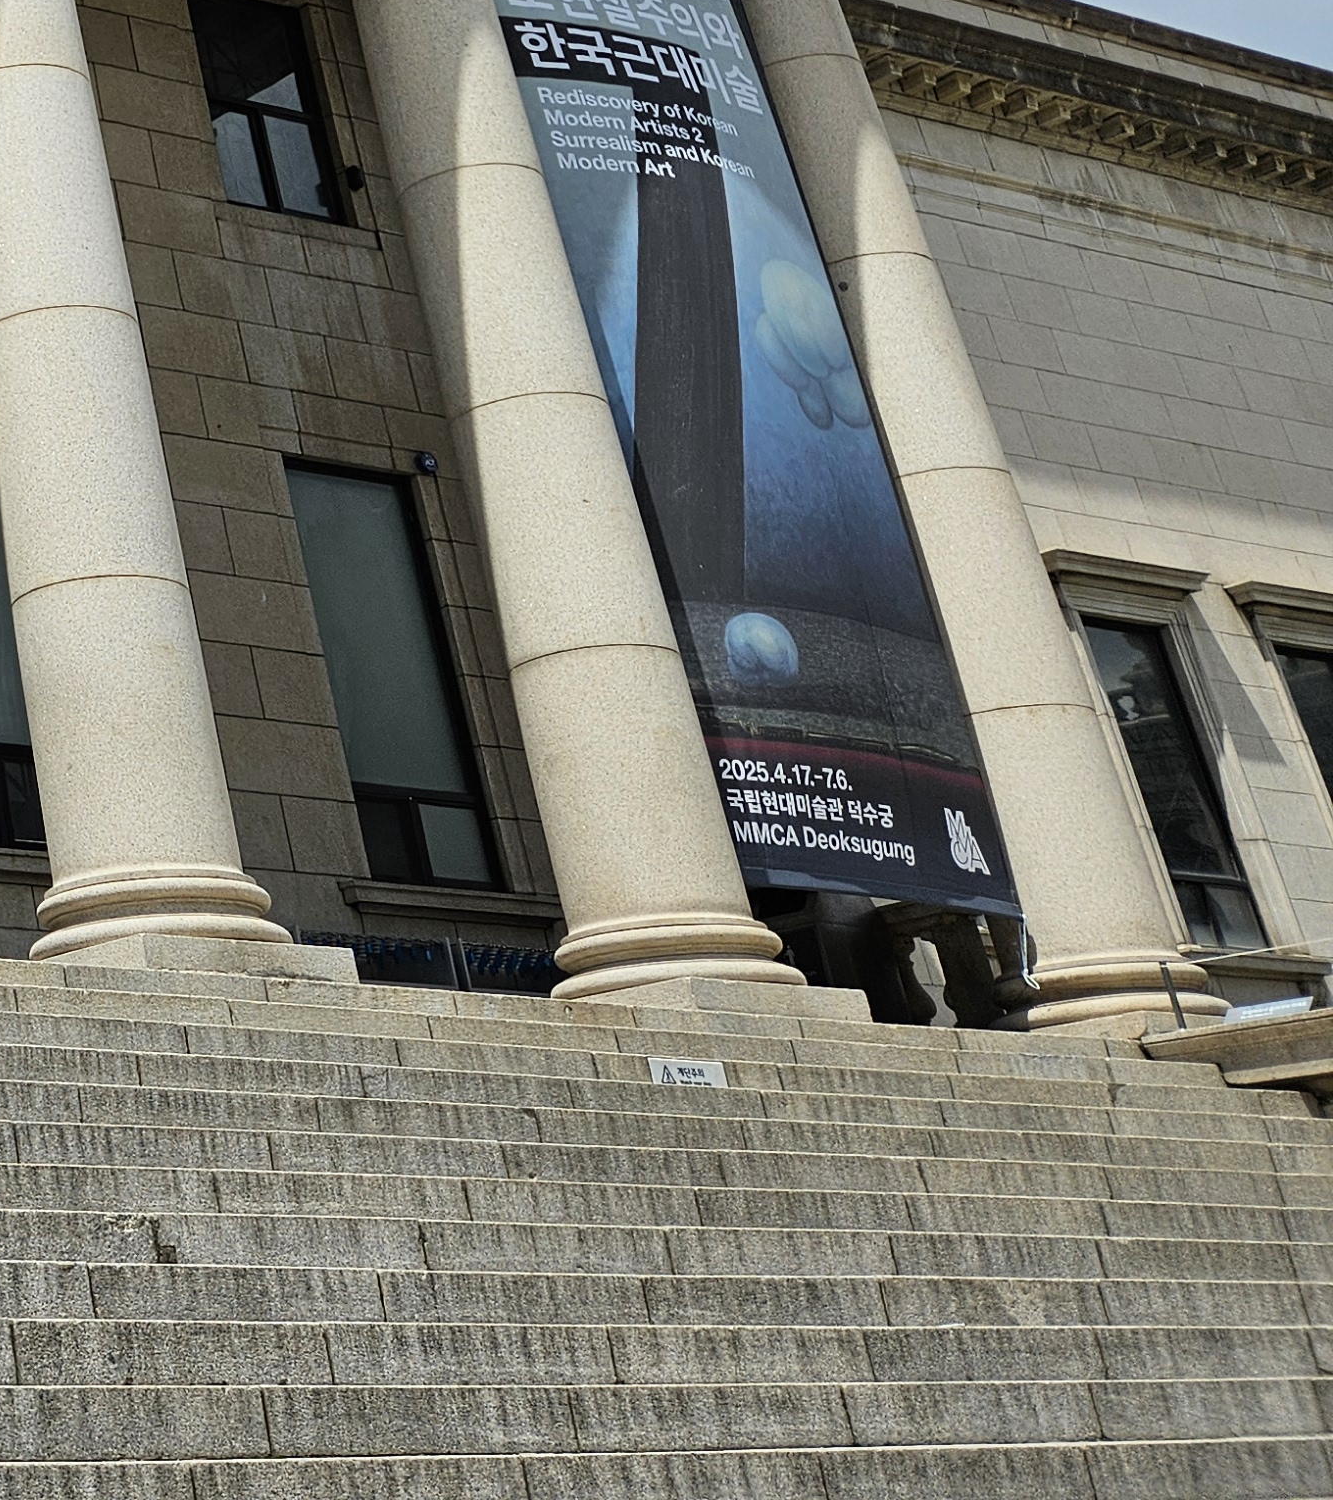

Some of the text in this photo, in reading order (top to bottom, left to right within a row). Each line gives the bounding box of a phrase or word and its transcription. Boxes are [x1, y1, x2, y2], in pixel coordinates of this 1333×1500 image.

[514, 21, 763, 115] 한국근대미술
[537, 87, 739, 136] Rediscovery of Korean
[544, 110, 705, 143] Modern Artists 2
[551, 132, 755, 178] Surrealism and Korean
[558, 153, 676, 178] Modern Art
[719, 759, 853, 791] 2025.4.17.-7.6.
[726, 789, 894, 828] 국립현대미술관 덕수궁
[733, 820, 915, 867] MMCA Deoksugung
[677, 1067, 705, 1079] 계단주의
